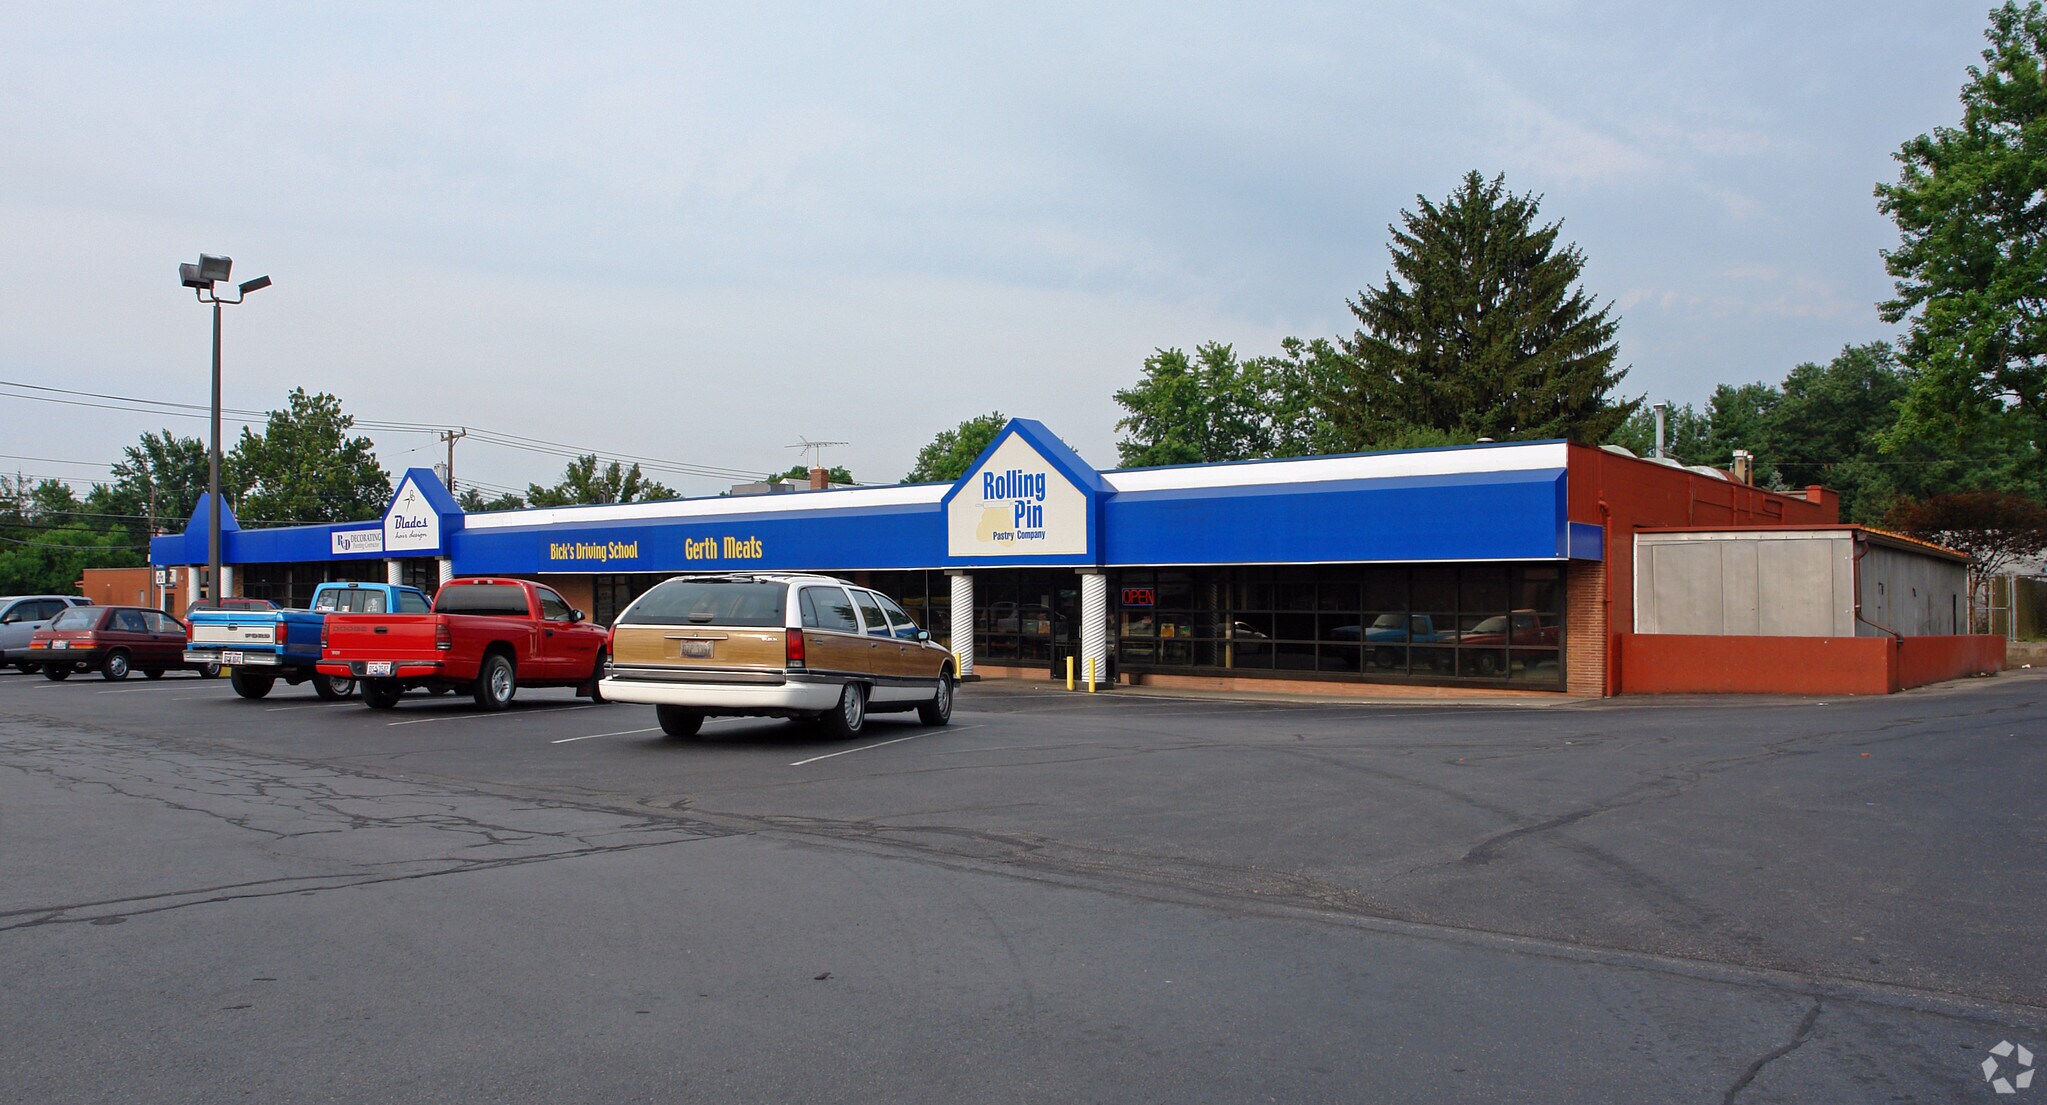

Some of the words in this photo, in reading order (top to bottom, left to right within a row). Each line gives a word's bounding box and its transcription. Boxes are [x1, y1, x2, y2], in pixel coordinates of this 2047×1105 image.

[983, 470, 1046, 502] Rolling
[395, 515, 428, 529] Blades
[1014, 500, 1043, 529] Pin
[350, 533, 382, 542] DECORATING
[395, 531, 408, 539] hair
[409, 530, 427, 541] design
[993, 531, 1014, 541] Pastry
[1017, 530, 1046, 540] Company
[550, 543, 575, 560] Bick's
[576, 542, 607, 562] Driving
[608, 540, 639, 559] School
[685, 537, 718, 560] Gerth
[723, 535, 763, 560] Meats
[1123, 589, 1155, 605] OPEN
